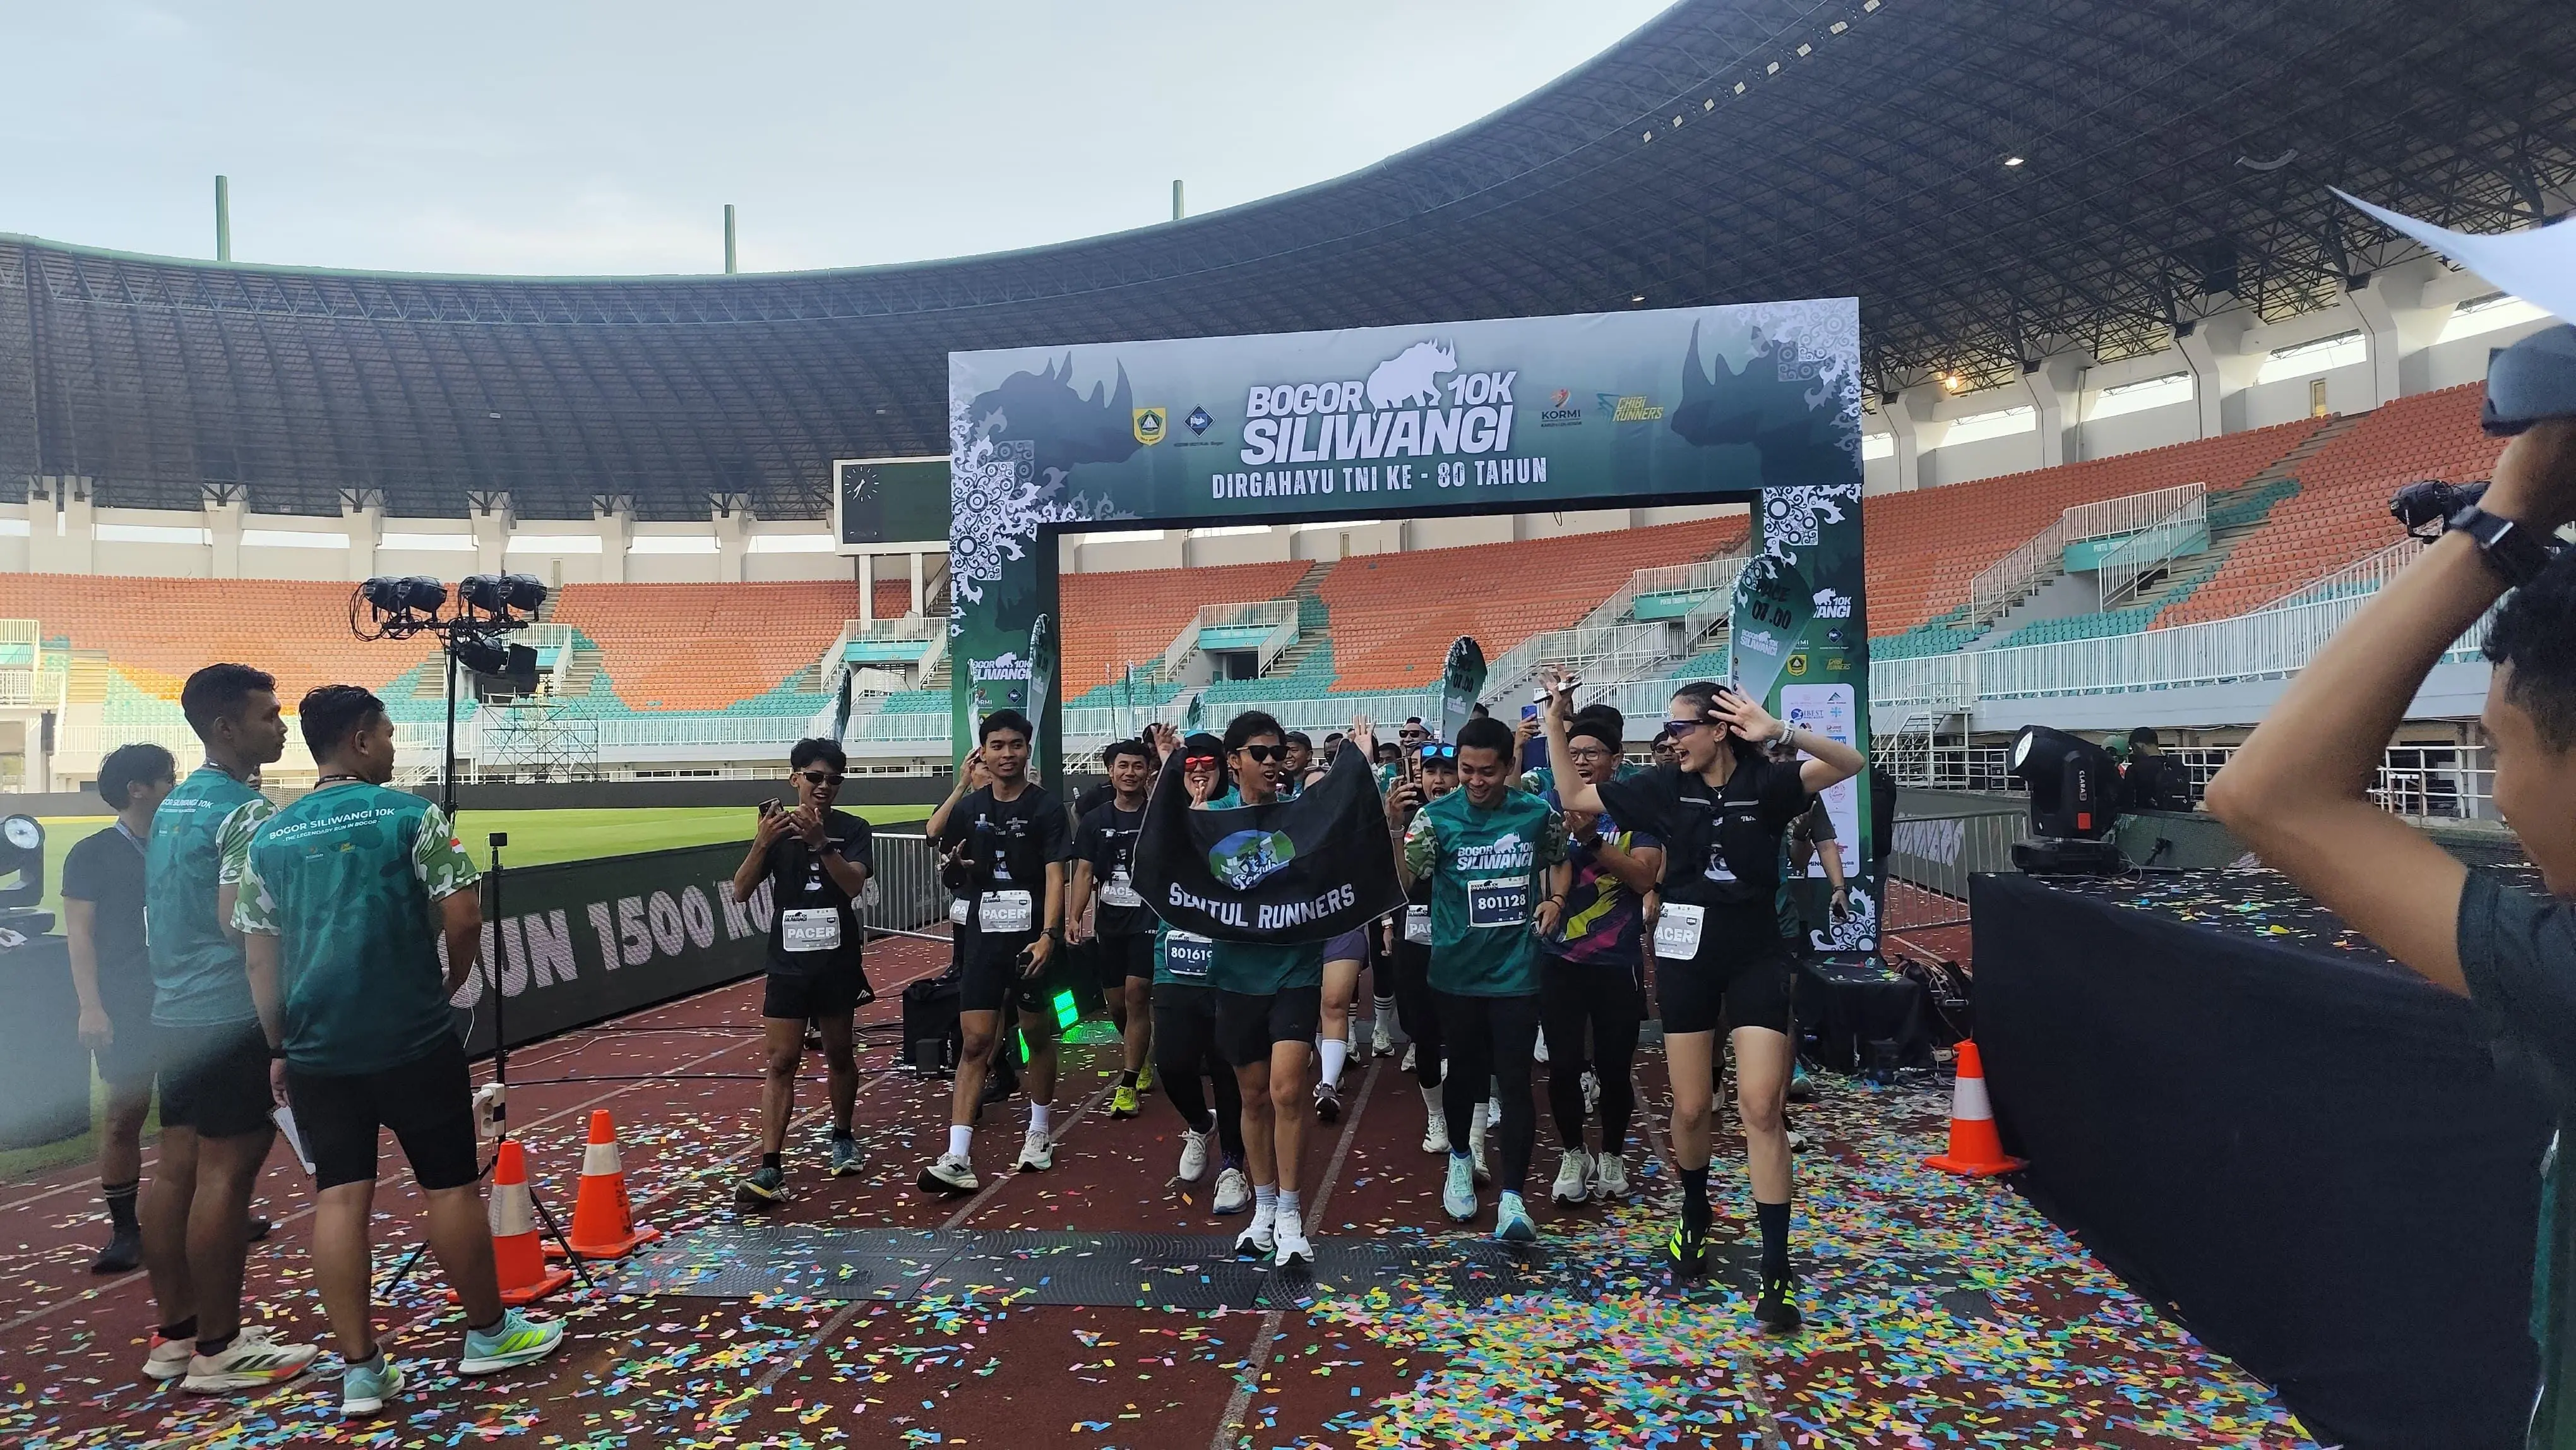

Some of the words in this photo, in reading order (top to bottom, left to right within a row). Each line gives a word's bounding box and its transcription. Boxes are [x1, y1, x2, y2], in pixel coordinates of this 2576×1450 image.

[1246, 381, 1364, 417] BOGOR
[1447, 371, 1517, 406] 10K
[1616, 395, 1647, 410] CHIBI
[1541, 409, 1581, 421] KORMI
[1612, 407, 1664, 422] RUNNERS
[1240, 405, 1513, 465] SILIWANGI
[1212, 468, 1333, 500] DIRGAHAYU
[1343, 465, 1378, 493] TNI
[1387, 464, 1412, 490] KE
[1438, 461, 1465, 488] 80
[1475, 457, 1547, 486] TAHUN
[1832, 596, 1852, 605] 10K
[1813, 605, 1851, 618] ANGI
[977, 668, 1030, 680] LIWANGI
[198, 800, 215, 809] 10K
[269, 822, 307, 840] BOGOR
[310, 811, 373, 829] SILIWANGI
[375, 808, 395, 816] 10K
[297, 828, 333, 839] LEGENDARY
[355, 819, 377, 827] BOGOR
[1458, 845, 1493, 857] BOGOR
[1517, 841, 1535, 853] 10K
[1456, 851, 1534, 871] SILIWANGI
[1169, 882, 1249, 928] SENTUL
[1258, 883, 1356, 930] RUNNERS
[1478, 894, 1526, 910] 801128
[982, 908, 1027, 920] PACER
[587, 885, 715, 971] 1500
[787, 926, 835, 938] PACER
[1409, 923, 1432, 933] PAC
[1655, 926, 1695, 944] ACER
